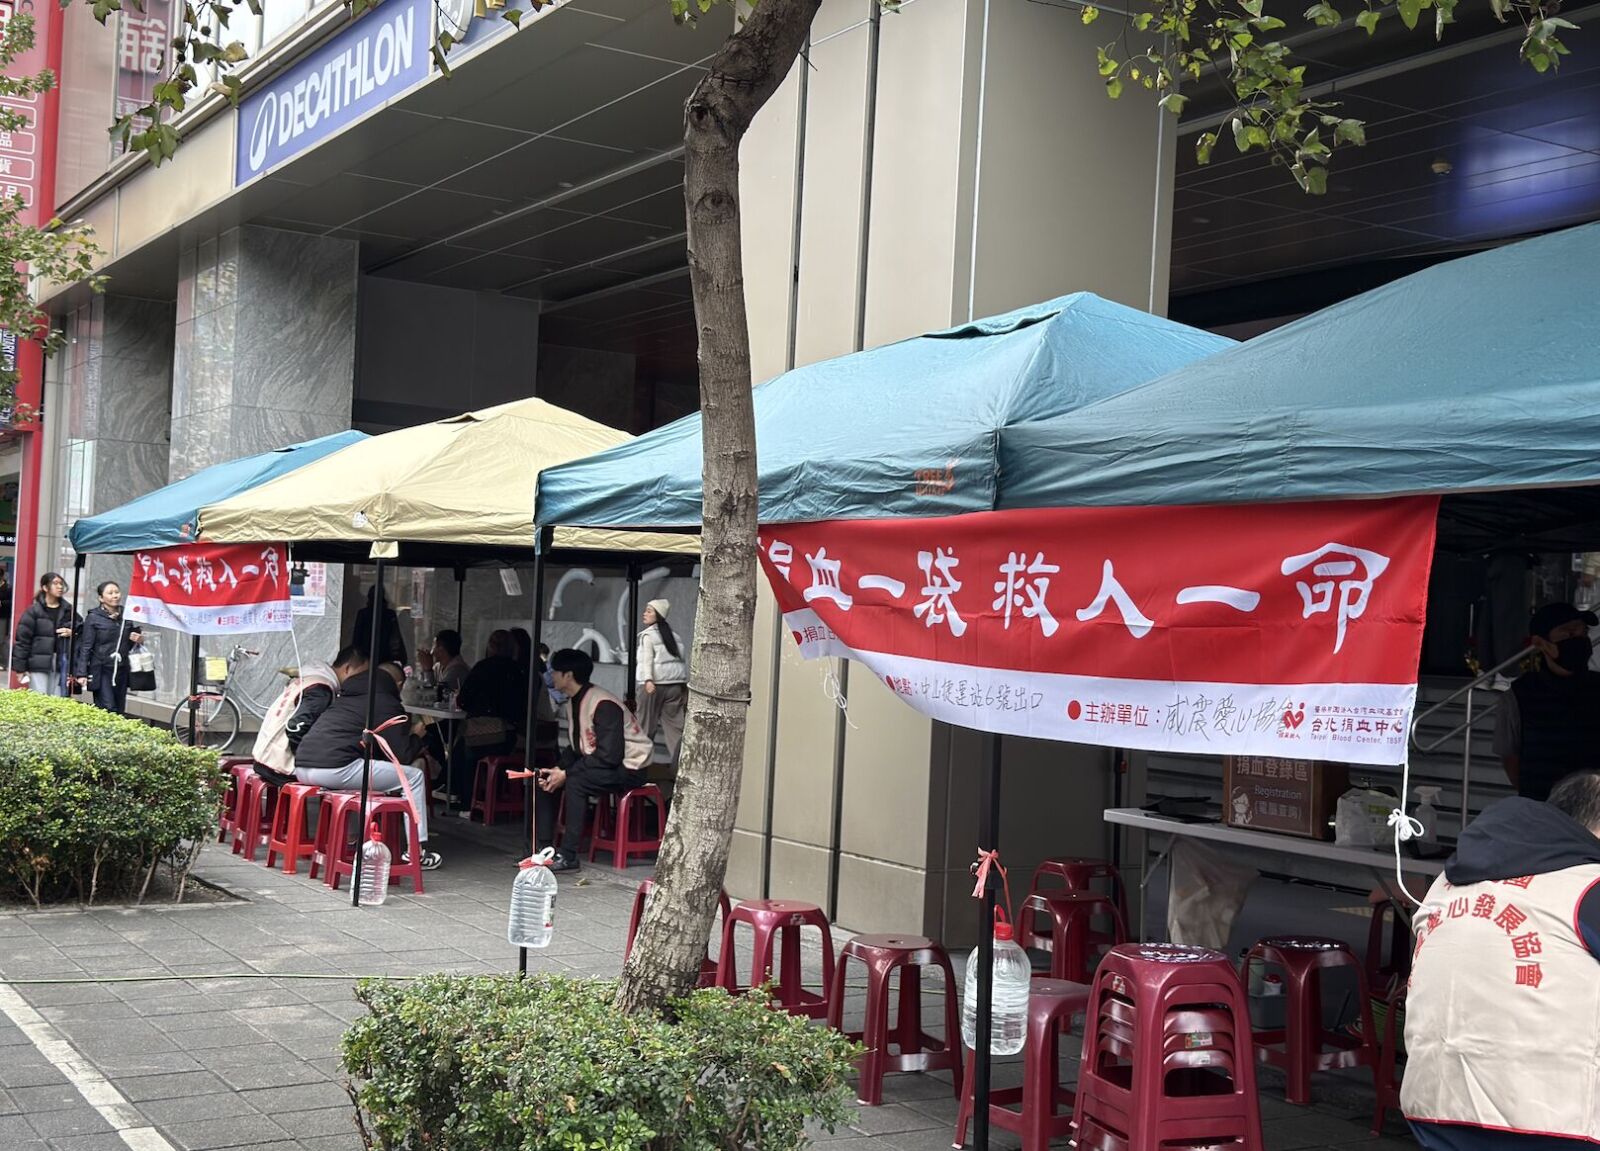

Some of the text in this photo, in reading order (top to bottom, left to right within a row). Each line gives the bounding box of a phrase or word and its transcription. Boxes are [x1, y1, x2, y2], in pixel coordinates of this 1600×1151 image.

[278, 6, 414, 147] DECATHLON
[1311, 717, 1403, 736] 台北捐血中心
[1254, 784, 1302, 800] Registration
